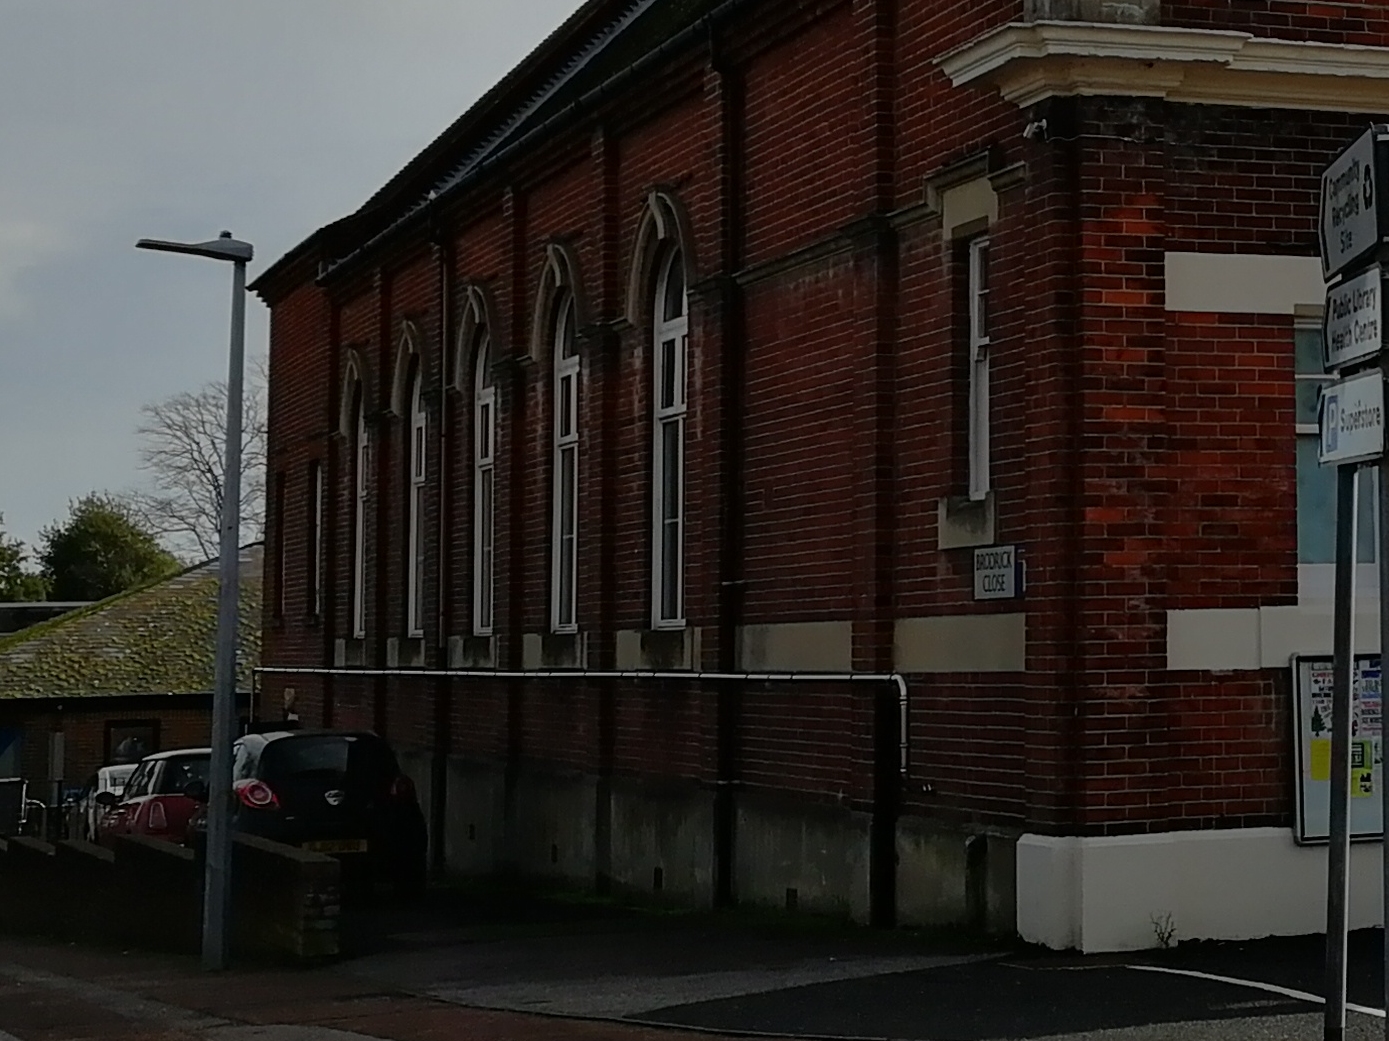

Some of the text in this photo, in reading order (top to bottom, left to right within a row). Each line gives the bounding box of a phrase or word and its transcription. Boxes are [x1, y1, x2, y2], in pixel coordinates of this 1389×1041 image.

[1340, 229, 1353, 254] Site
[1332, 287, 1376, 320] Public Library
[1331, 318, 1378, 352] Health Centre
[1340, 406, 1381, 435] Superstore
[983, 574, 1005, 592] CLOSE
